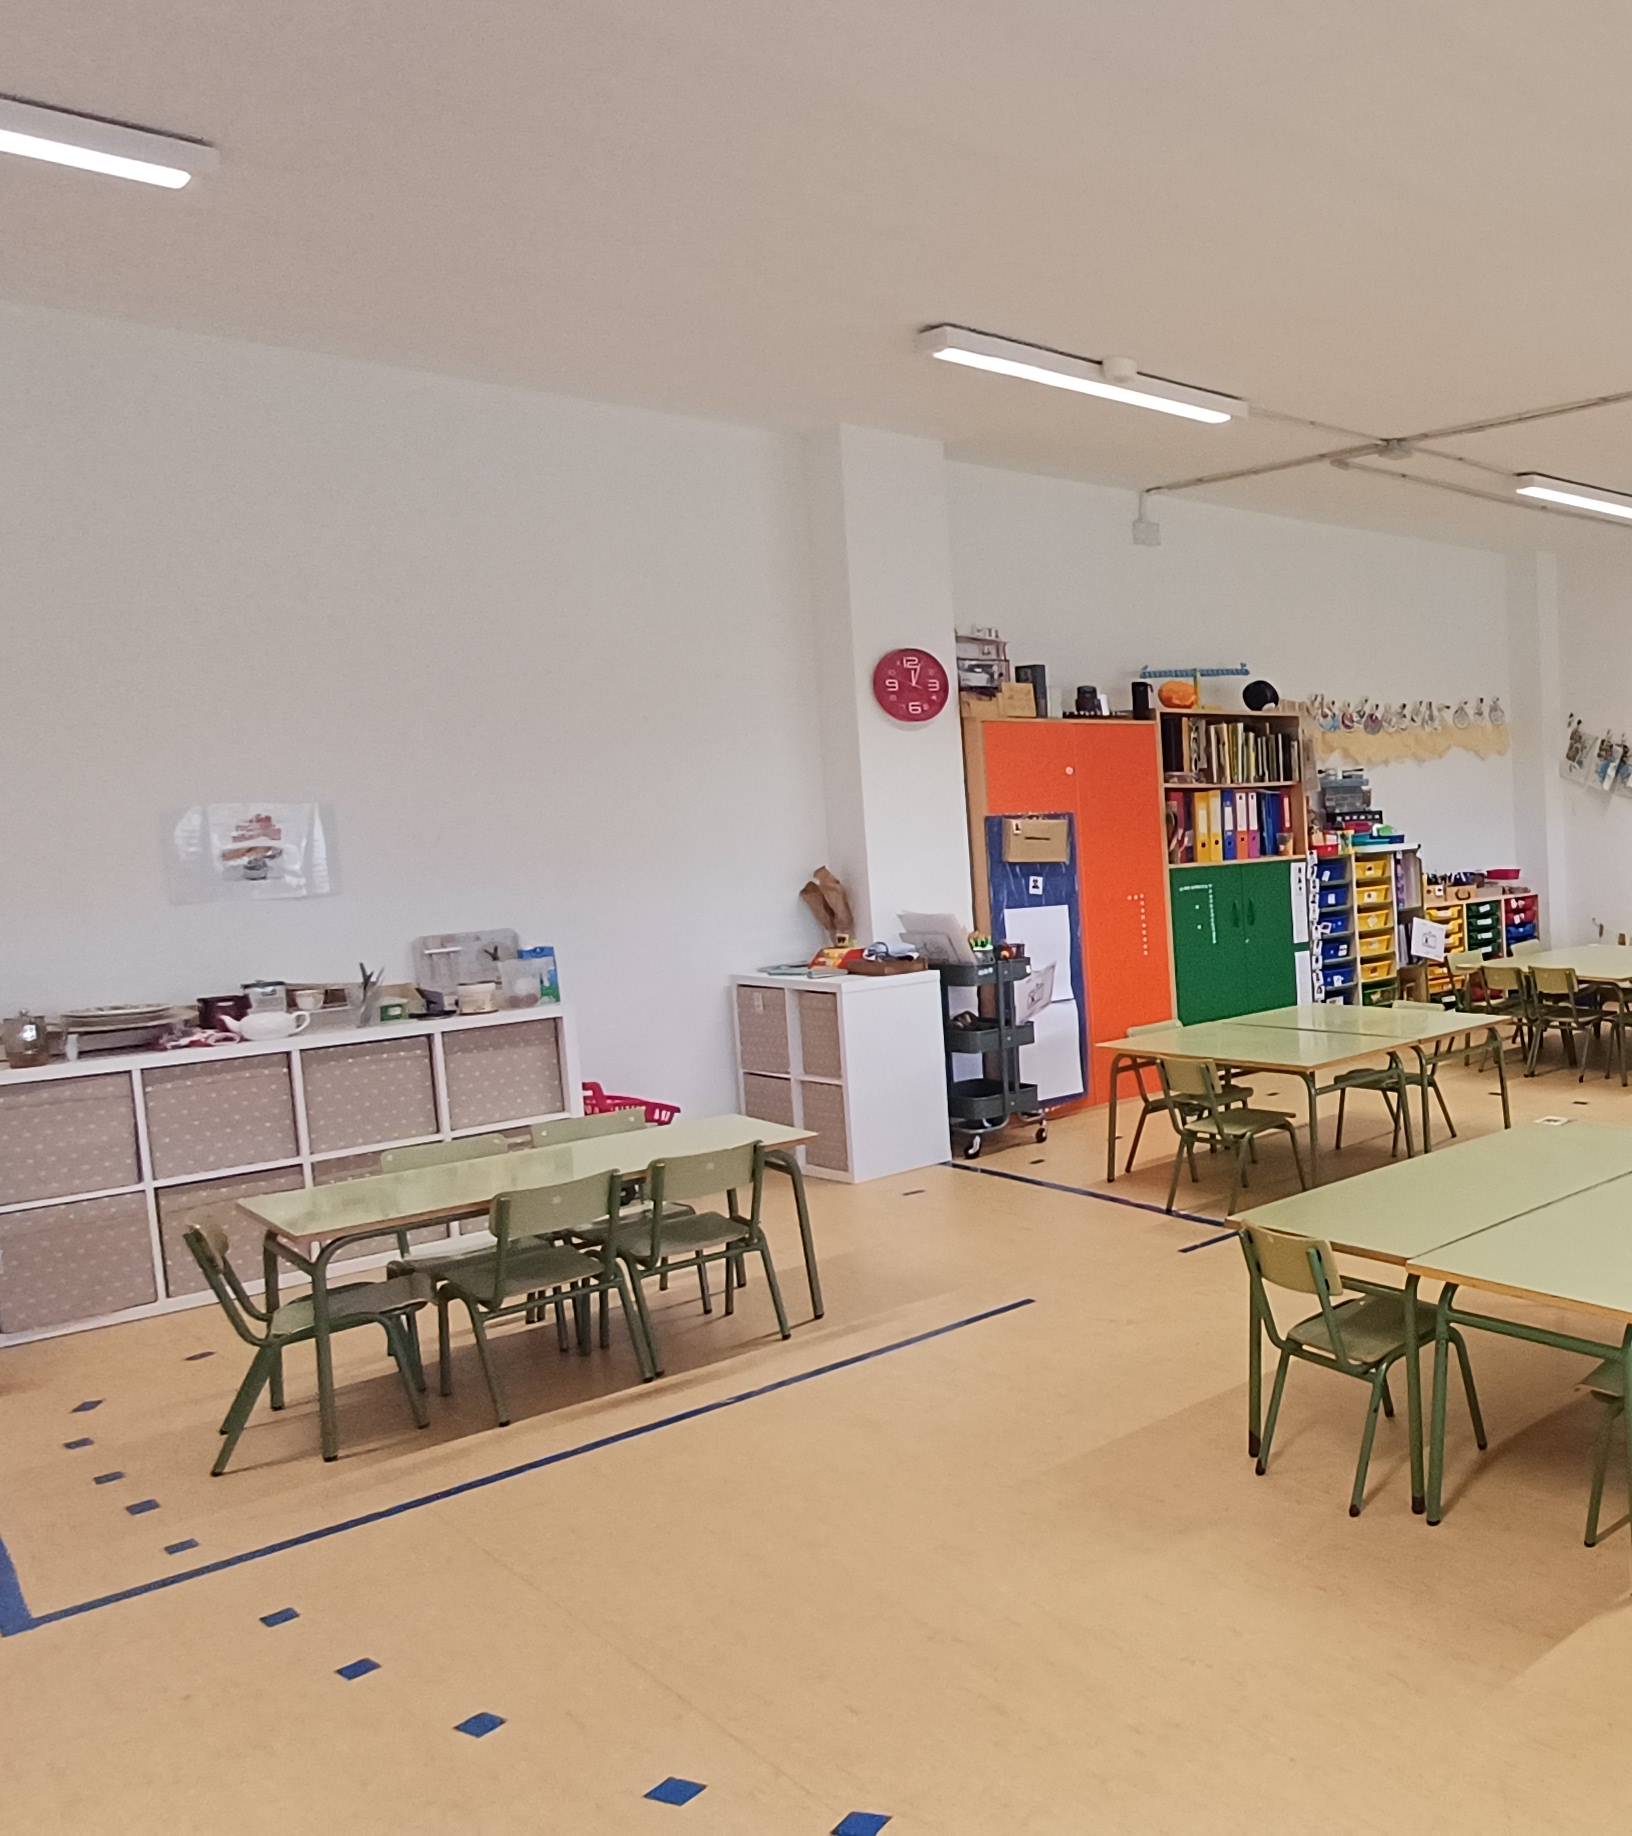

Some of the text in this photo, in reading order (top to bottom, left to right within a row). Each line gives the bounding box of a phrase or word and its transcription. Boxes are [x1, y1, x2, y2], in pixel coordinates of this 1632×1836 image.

[903, 657, 919, 668] 12
[885, 679, 899, 692] 9
[927, 680, 940, 692] 3
[908, 701, 922, 714] 6
